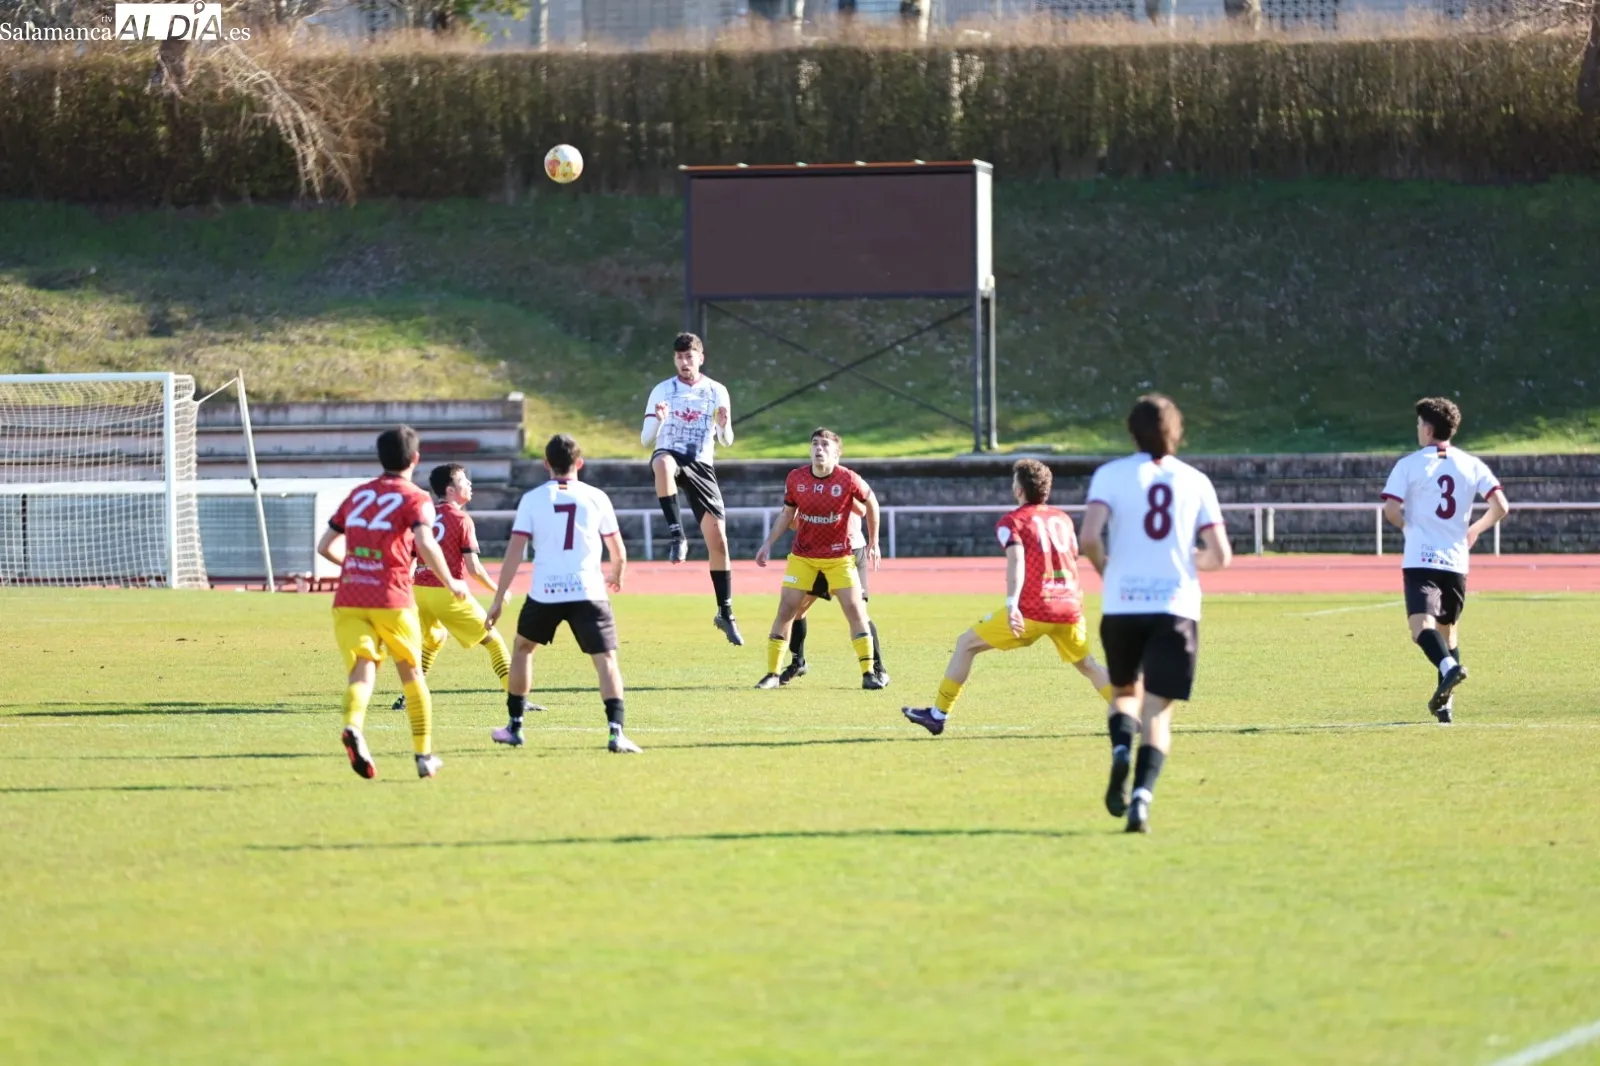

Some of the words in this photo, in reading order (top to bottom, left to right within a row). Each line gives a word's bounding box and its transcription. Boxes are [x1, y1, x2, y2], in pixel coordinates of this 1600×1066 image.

[345, 489, 404, 531] 22
[813, 483, 825, 495] 19
[1435, 473, 1457, 520] 3
[553, 503, 577, 551] 7
[1144, 482, 1173, 541] 8
[1031, 515, 1071, 554] 10
